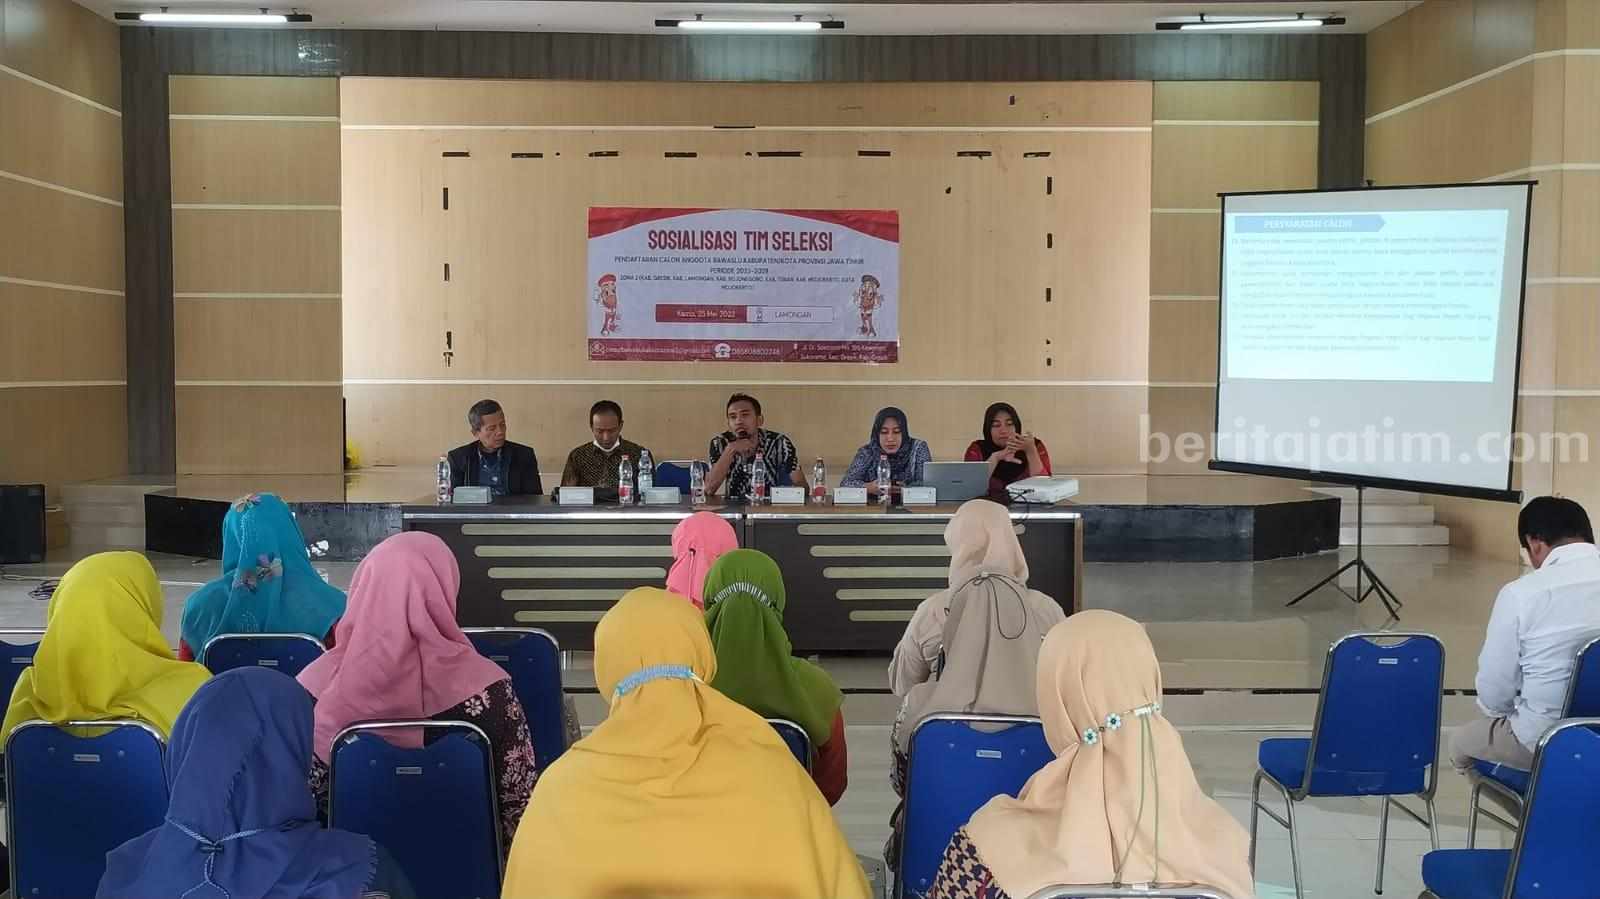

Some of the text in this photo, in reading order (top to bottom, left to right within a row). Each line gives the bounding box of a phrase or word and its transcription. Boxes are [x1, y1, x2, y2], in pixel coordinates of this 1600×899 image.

[648, 229, 833, 252] SOSIALISASI TIM SELEKSI
[658, 255, 681, 264] CALON
[797, 257, 827, 265] PROVINSI
[826, 257, 845, 265] JAWA
